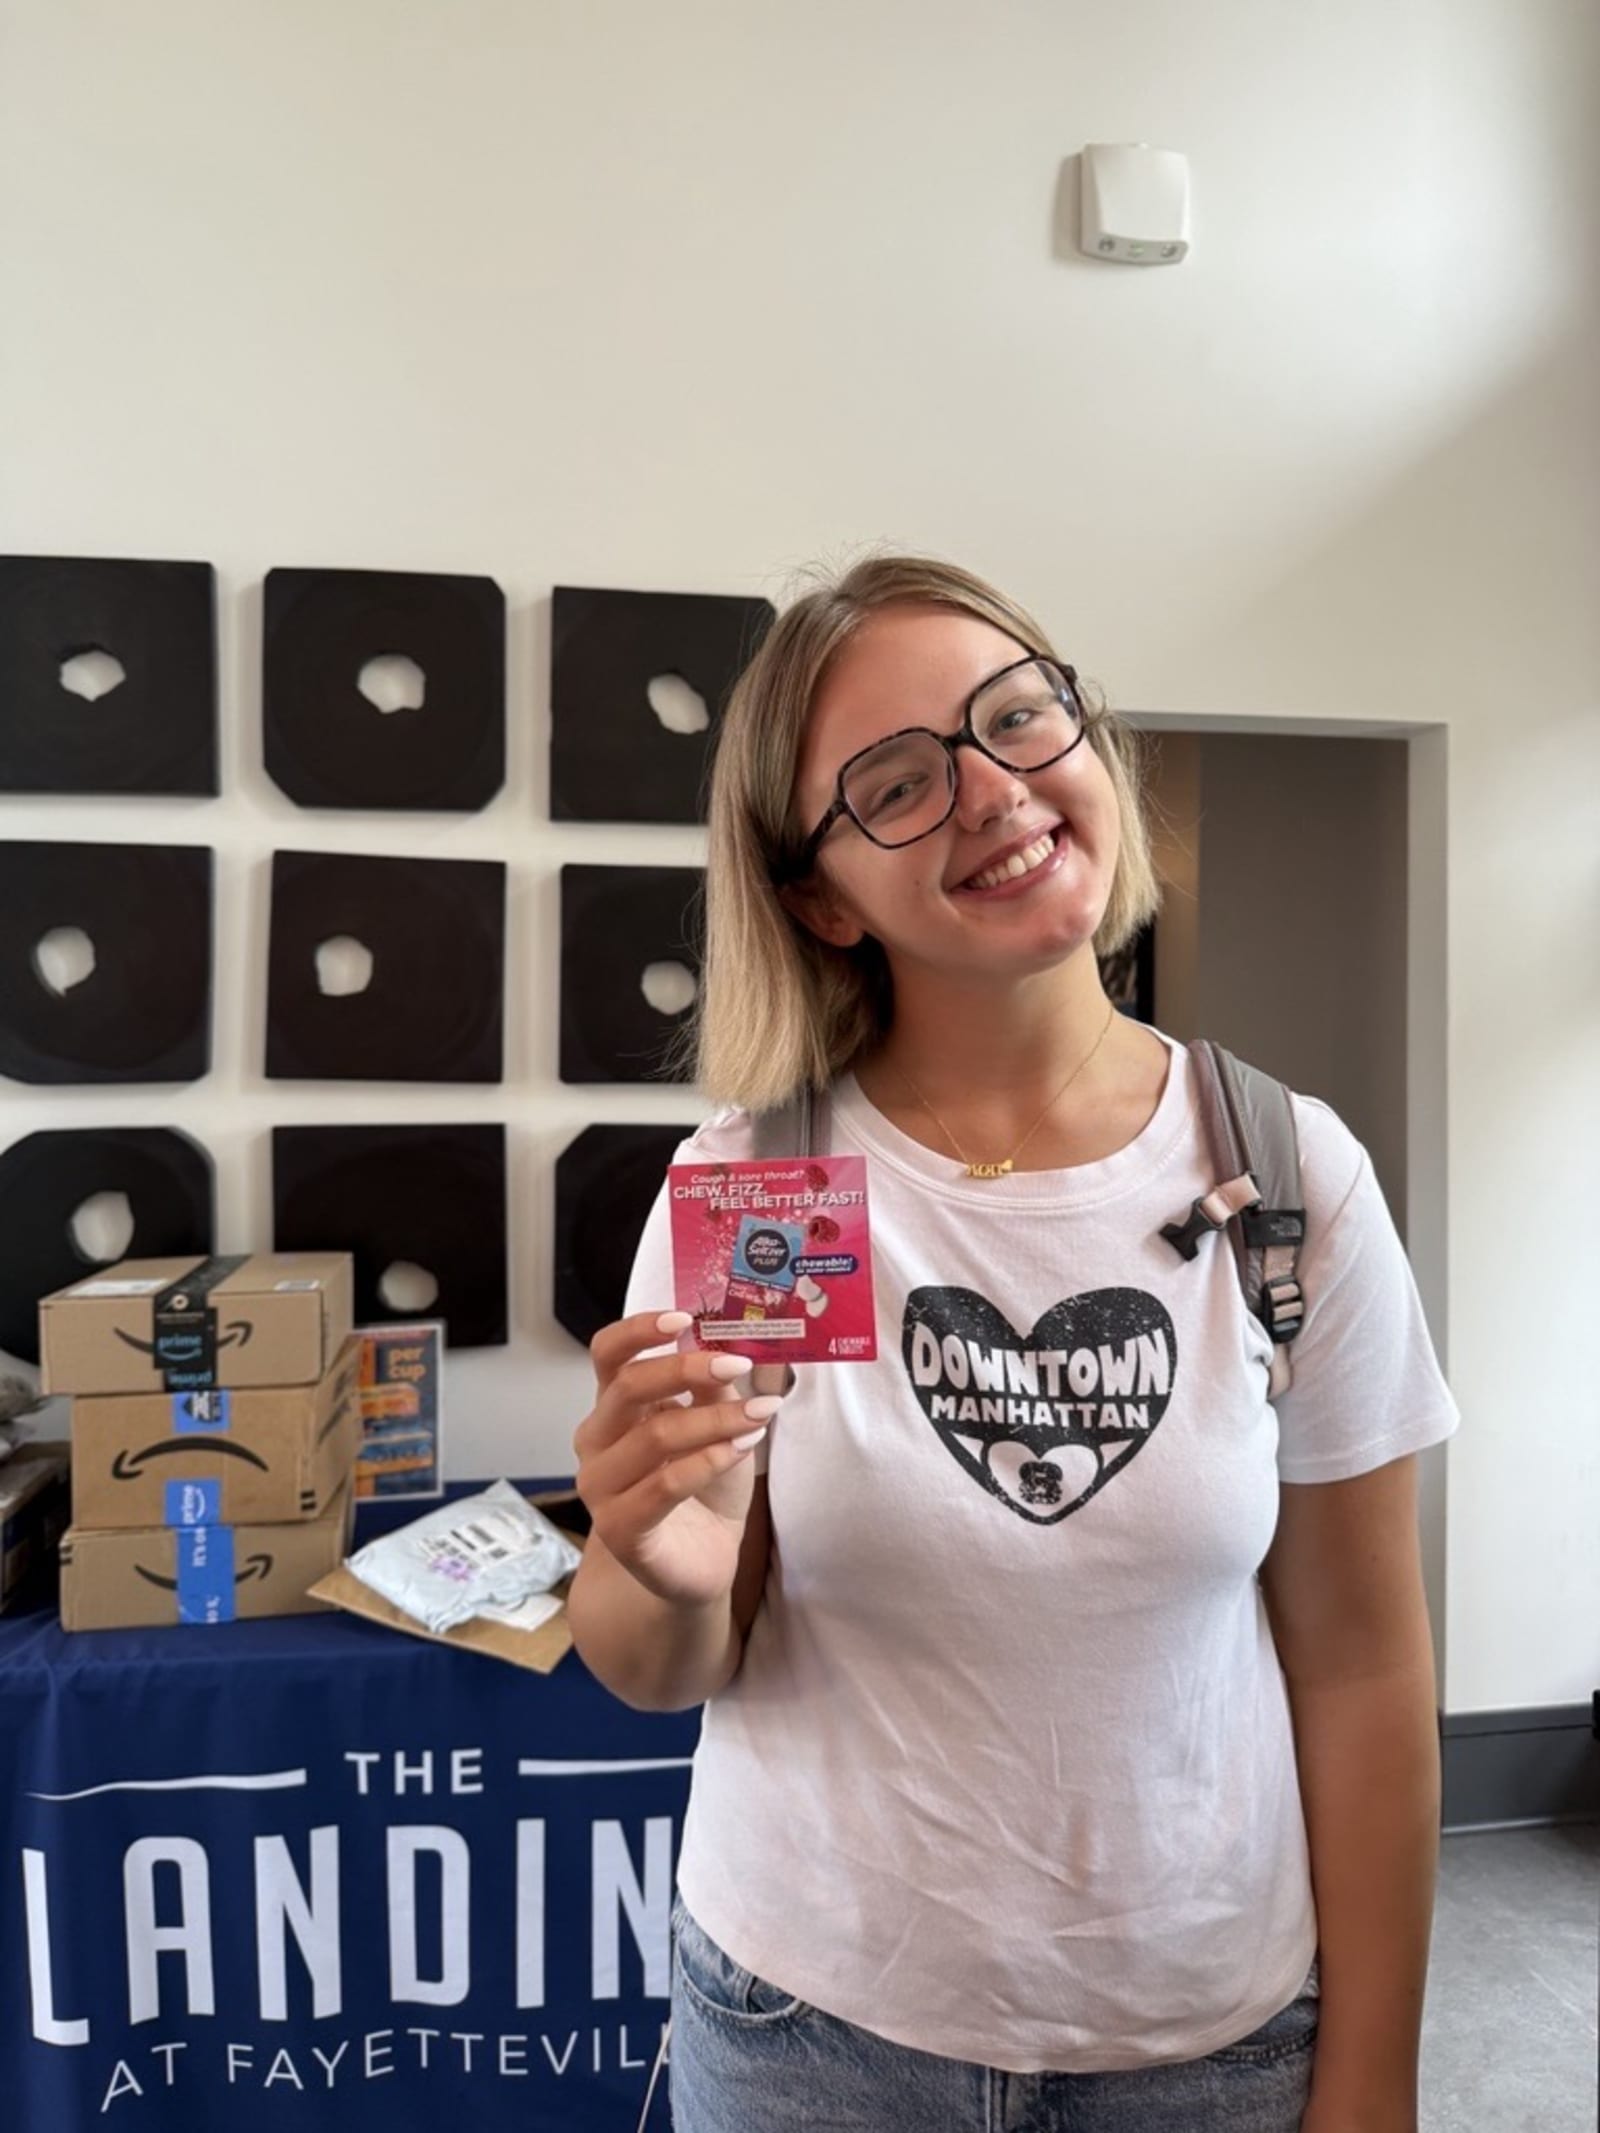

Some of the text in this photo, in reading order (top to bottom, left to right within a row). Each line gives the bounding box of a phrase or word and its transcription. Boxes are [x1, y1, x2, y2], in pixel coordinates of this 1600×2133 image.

[673, 1183, 767, 1199] CHEW. FIZZ.
[690, 1174, 725, 1184] Cough
[738, 1173, 762, 1182] sore
[710, 1191, 865, 1211] FEEL BETTER FAST!
[828, 1337, 838, 1355] 4
[911, 1321, 1170, 1398] DOWNTOWN
[931, 1394, 1150, 1430] MANHATTAN
[344, 1748, 484, 1794] THE
[21, 1816, 674, 2046] LANDIN
[100, 2042, 187, 2113] AT
